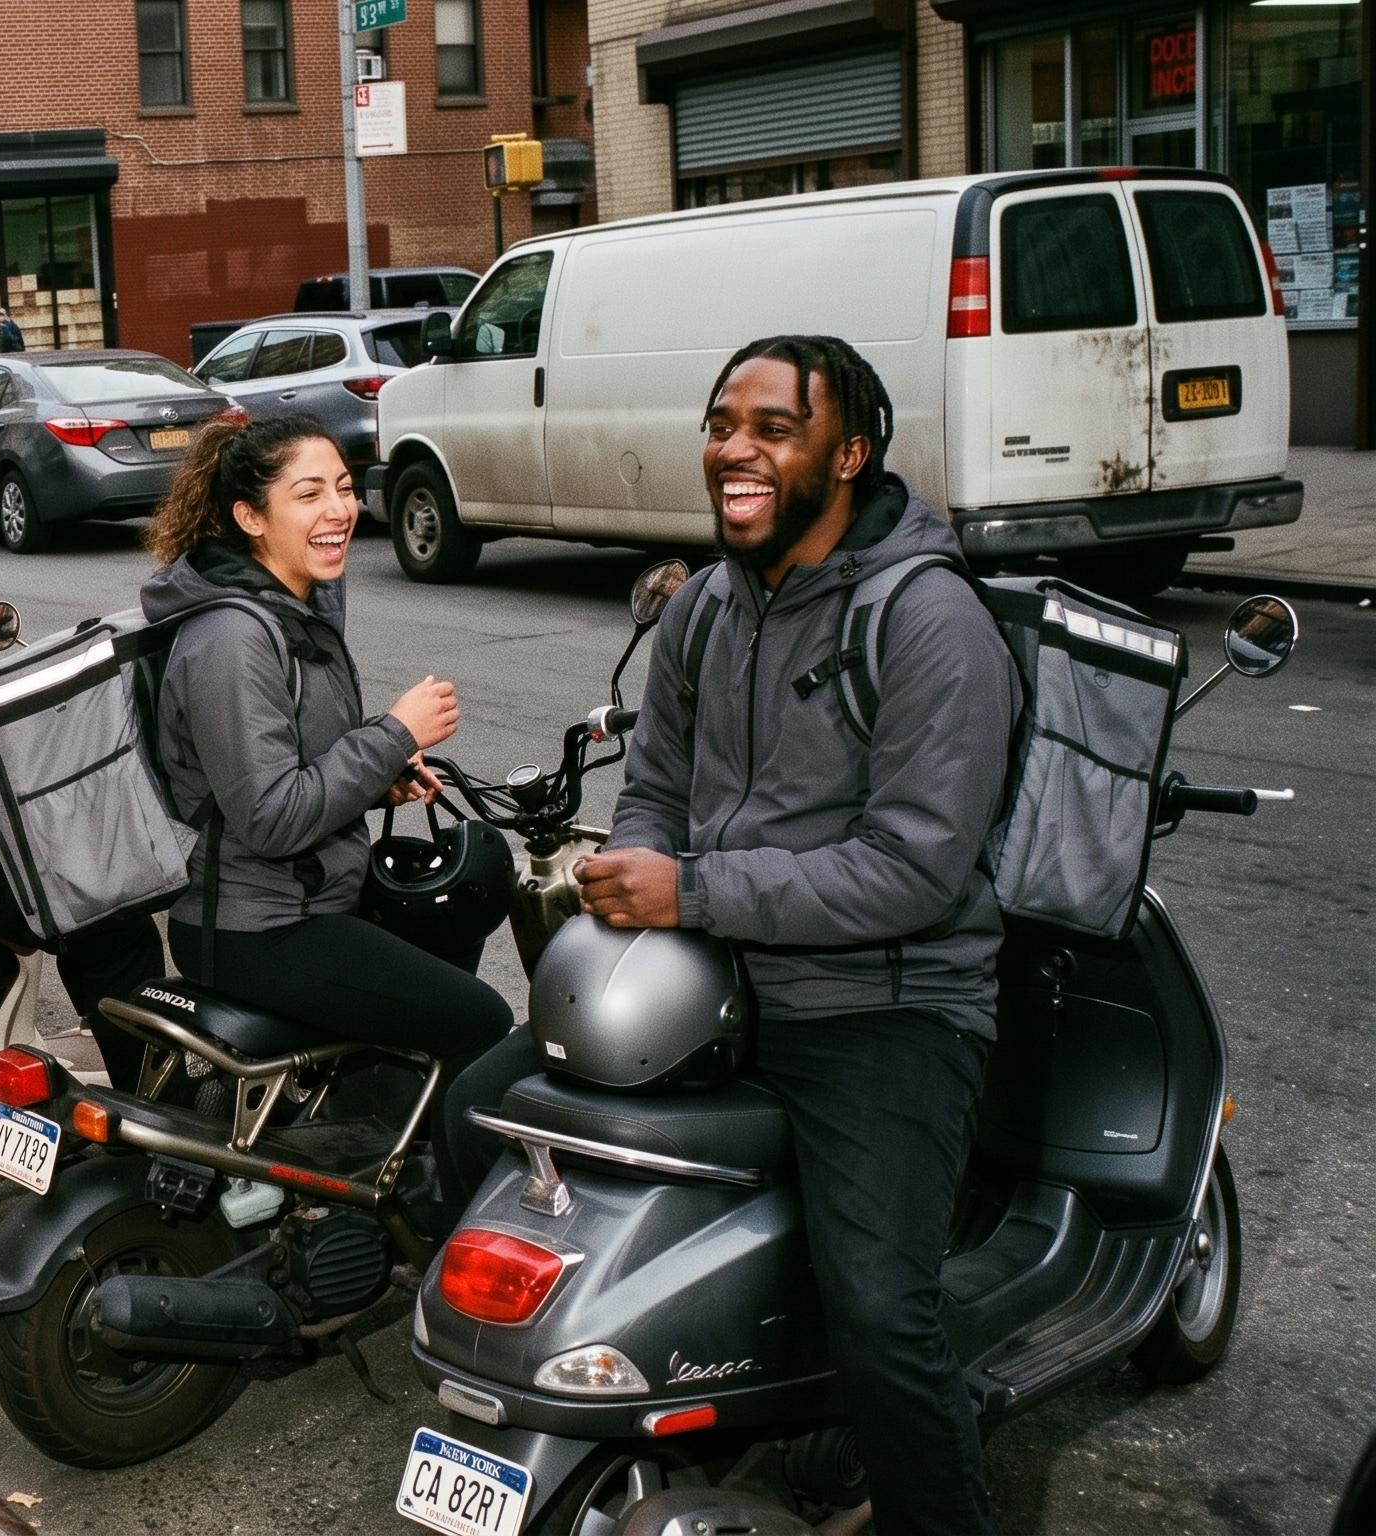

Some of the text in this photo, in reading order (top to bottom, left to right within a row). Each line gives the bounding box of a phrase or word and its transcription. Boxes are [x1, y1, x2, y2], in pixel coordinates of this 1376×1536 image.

[141, 987, 196, 1013] HONDA
[412, 1459, 443, 1505] CA
[448, 1474, 509, 1532] 82R1
